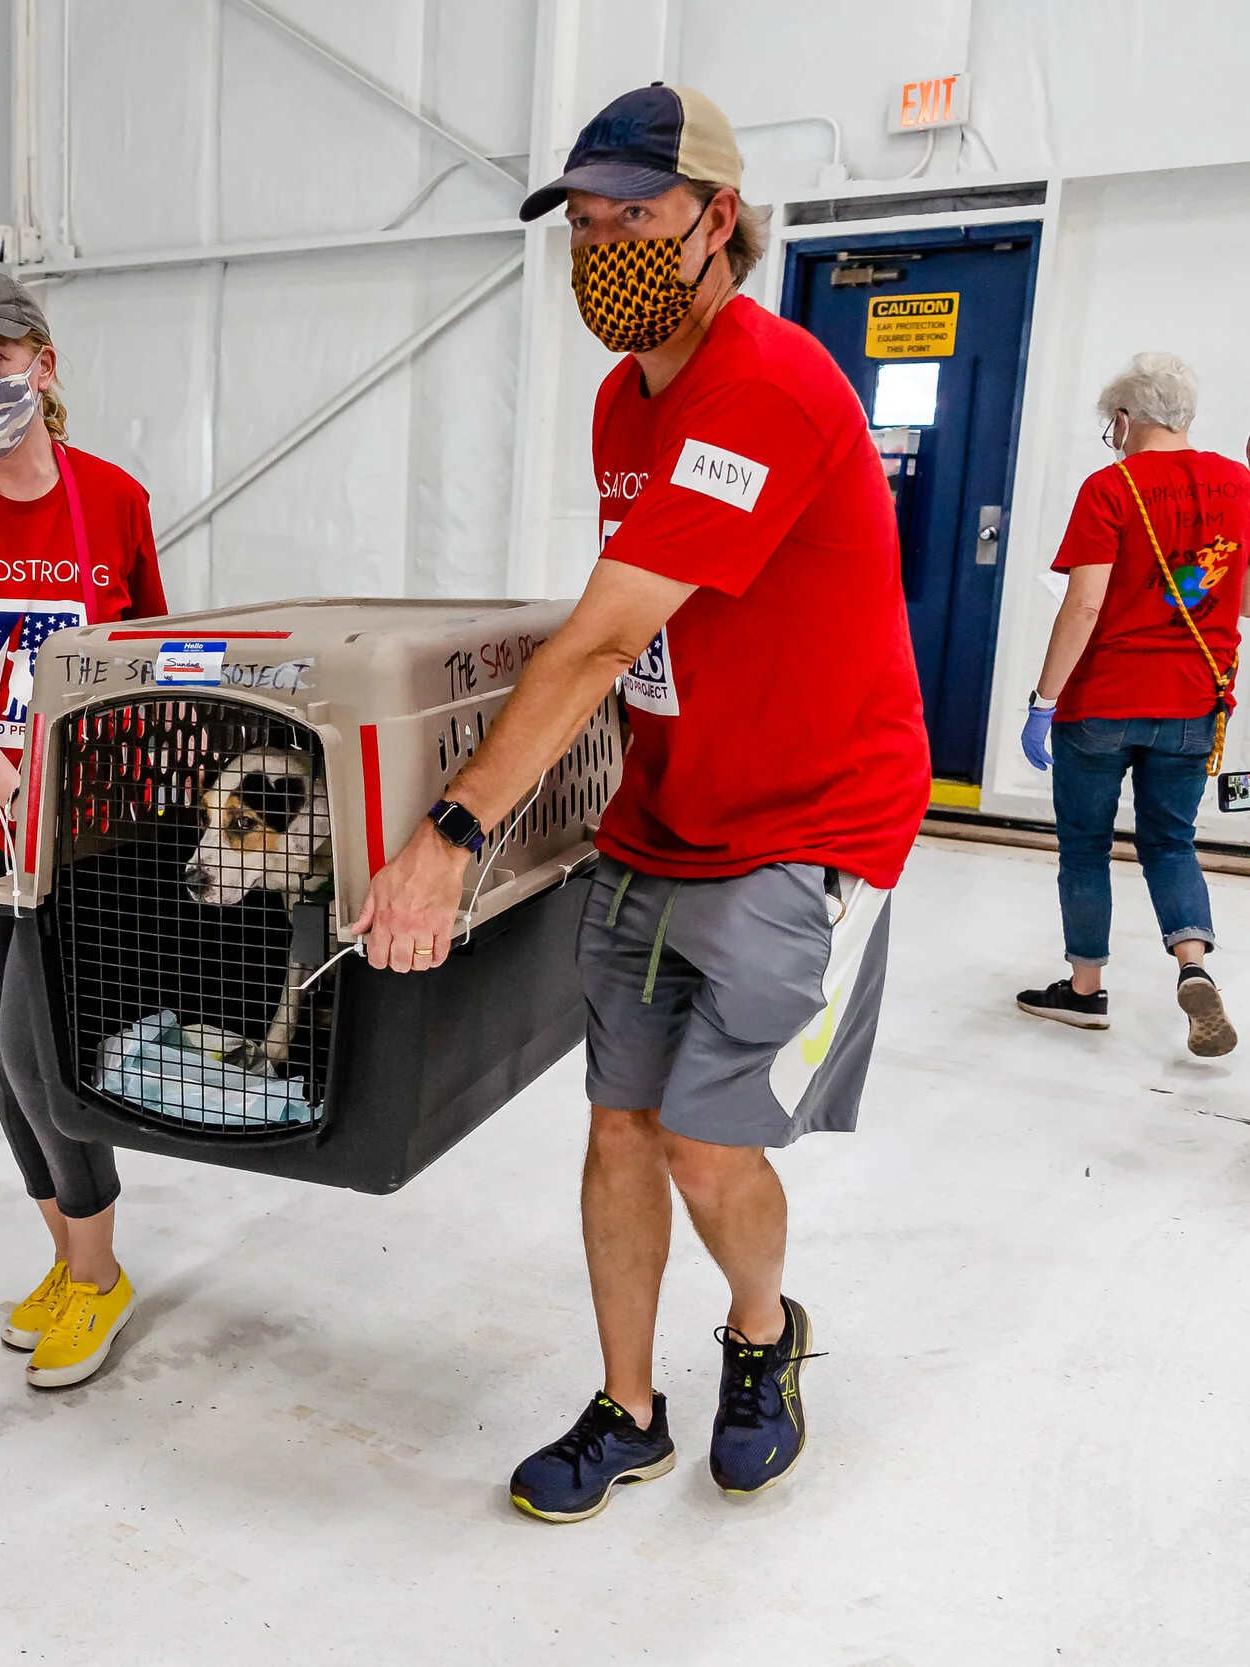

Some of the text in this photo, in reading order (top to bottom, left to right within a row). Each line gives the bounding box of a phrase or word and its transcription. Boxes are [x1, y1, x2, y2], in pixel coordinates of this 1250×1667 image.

[900, 76, 957, 128] EXIT
[877, 300, 949, 316] CAUTION
[877, 321, 946, 331] EAR PROTECTION
[914, 332, 948, 341] BEYOND
[886, 344, 931, 353] THIS POINT
[692, 454, 752, 495] ANDY
[1175, 511, 1223, 528] TEAM
[55, 654, 312, 696] THE SA ROJECT
[444, 650, 478, 701] THE
[480, 639, 515, 679] SATO
[634, 679, 668, 700] PROJECT
